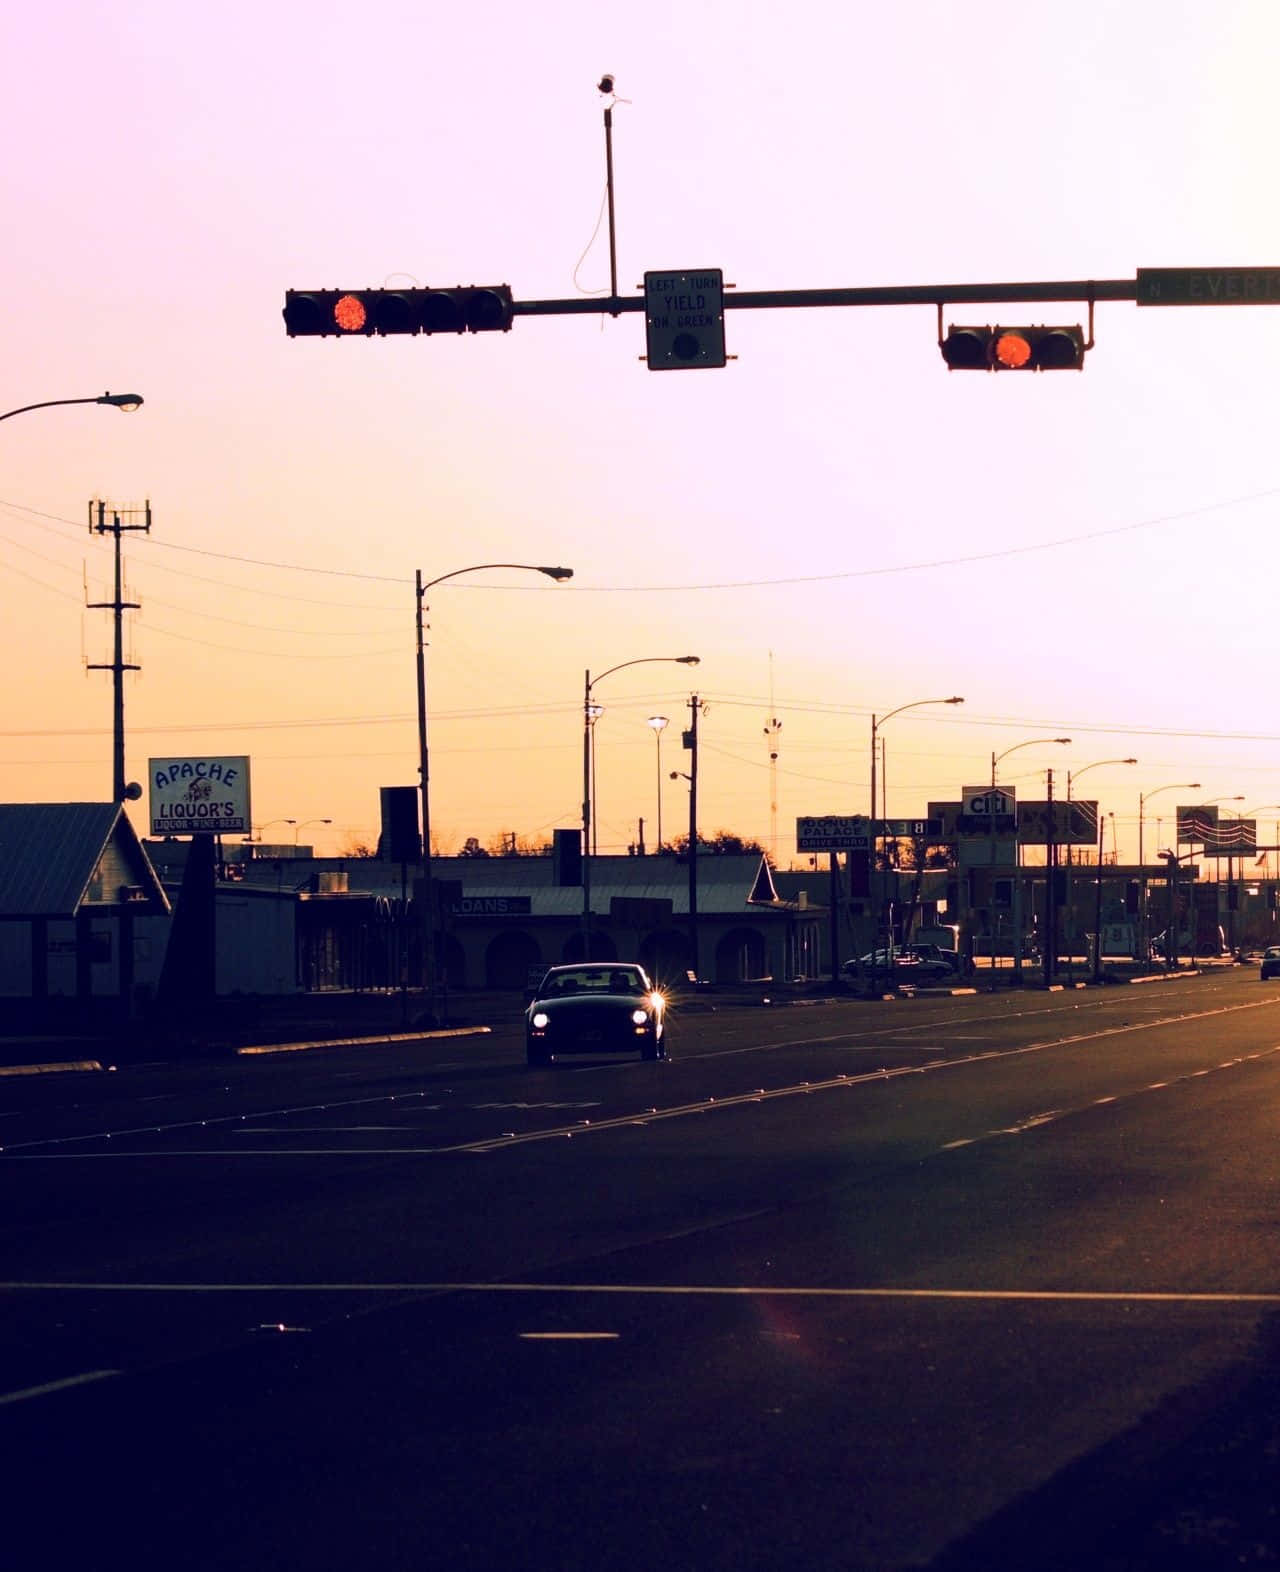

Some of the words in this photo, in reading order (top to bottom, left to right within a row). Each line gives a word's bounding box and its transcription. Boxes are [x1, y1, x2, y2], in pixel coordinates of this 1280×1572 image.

[649, 279, 676, 292] LEFT
[690, 277, 719, 290] TURN
[664, 295, 705, 310] YIELD
[155, 762, 238, 789] APACHE
[160, 801, 235, 818] LIQUOR'S
[804, 827, 862, 836] PALACE
[802, 838, 833, 847] DRIVE
[838, 838, 865, 846] THRU
[452, 899, 508, 913] LOANS
